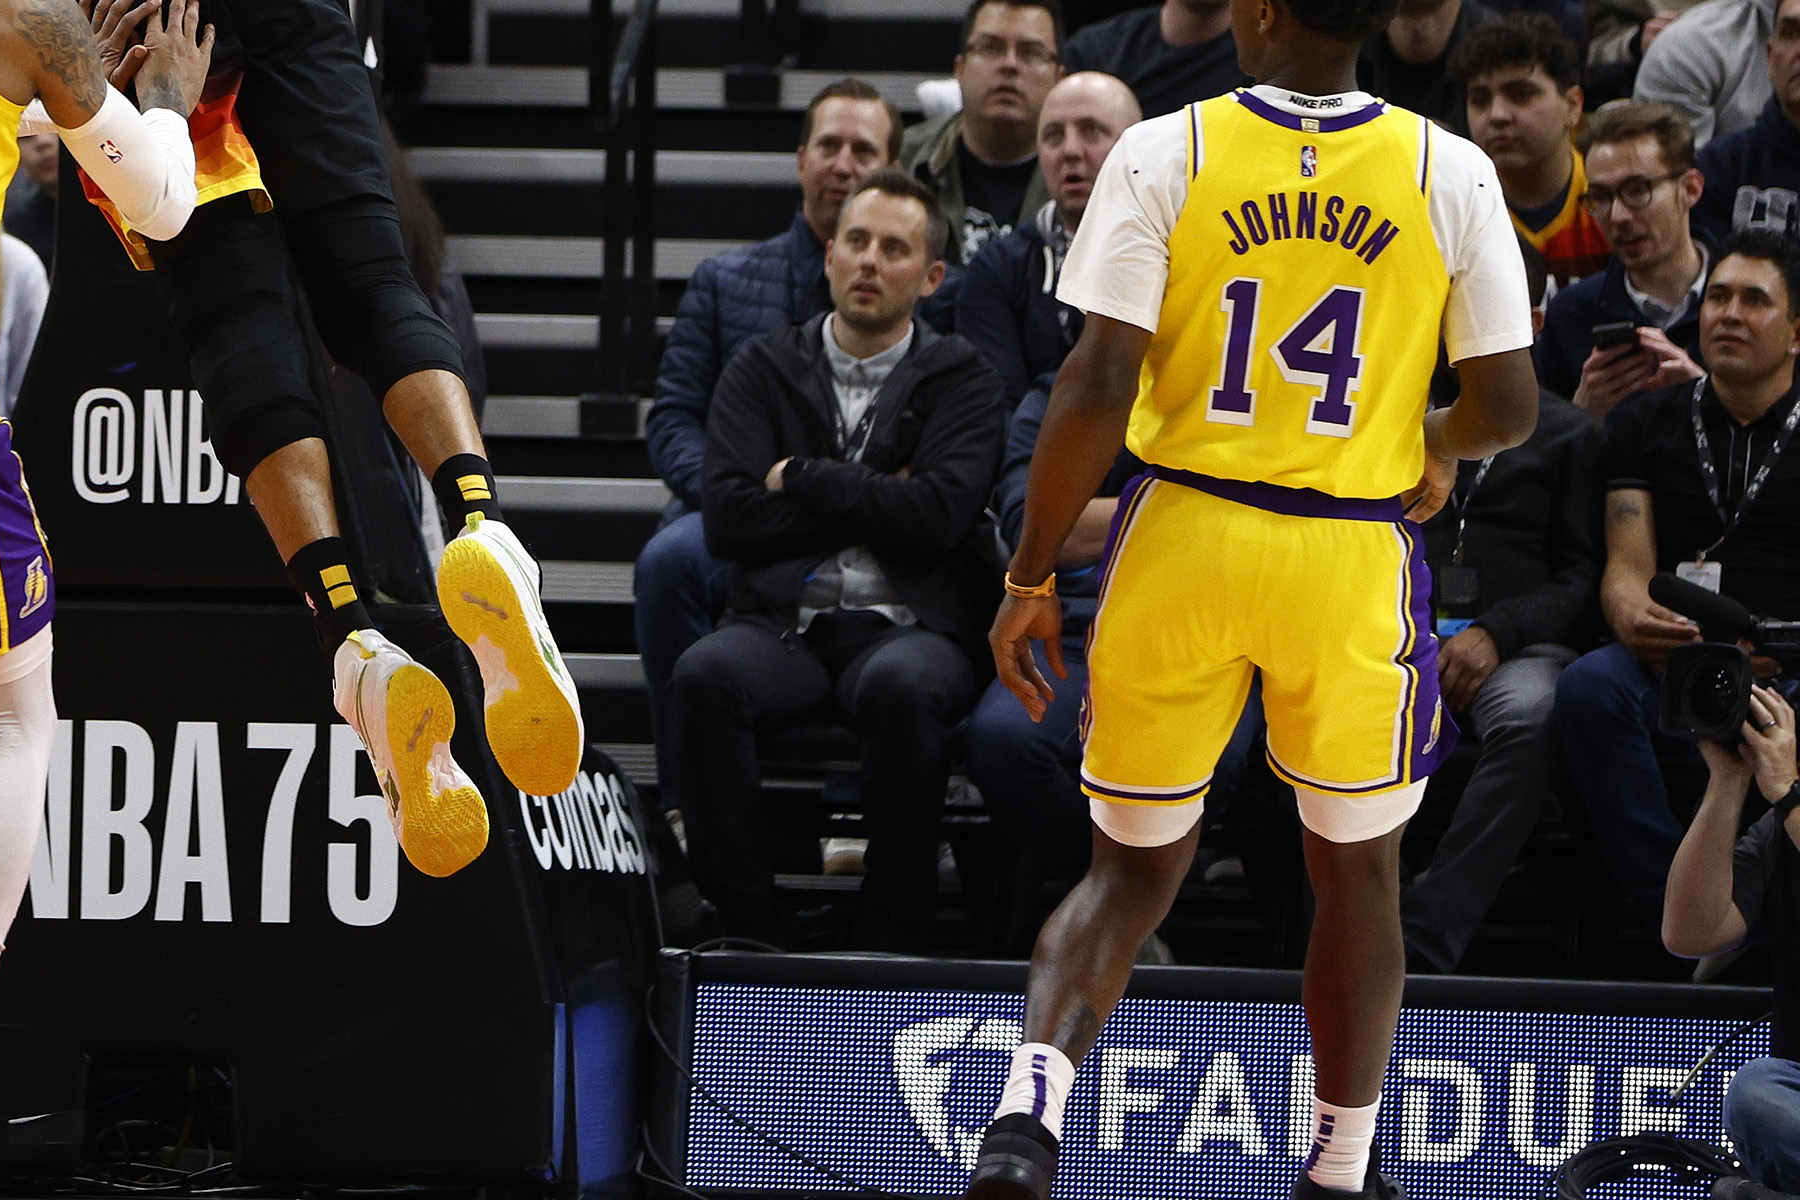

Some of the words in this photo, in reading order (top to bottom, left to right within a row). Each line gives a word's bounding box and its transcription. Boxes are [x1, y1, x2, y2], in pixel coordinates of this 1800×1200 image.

[1288, 95, 1319, 109] NIKE
[1320, 97, 1343, 109] PRO
[1221, 191, 1400, 267] JOHNSON
[1205, 275, 1367, 439] 14
[518, 769, 646, 876] comcas
[1097, 1047, 1740, 1171] FADUE
